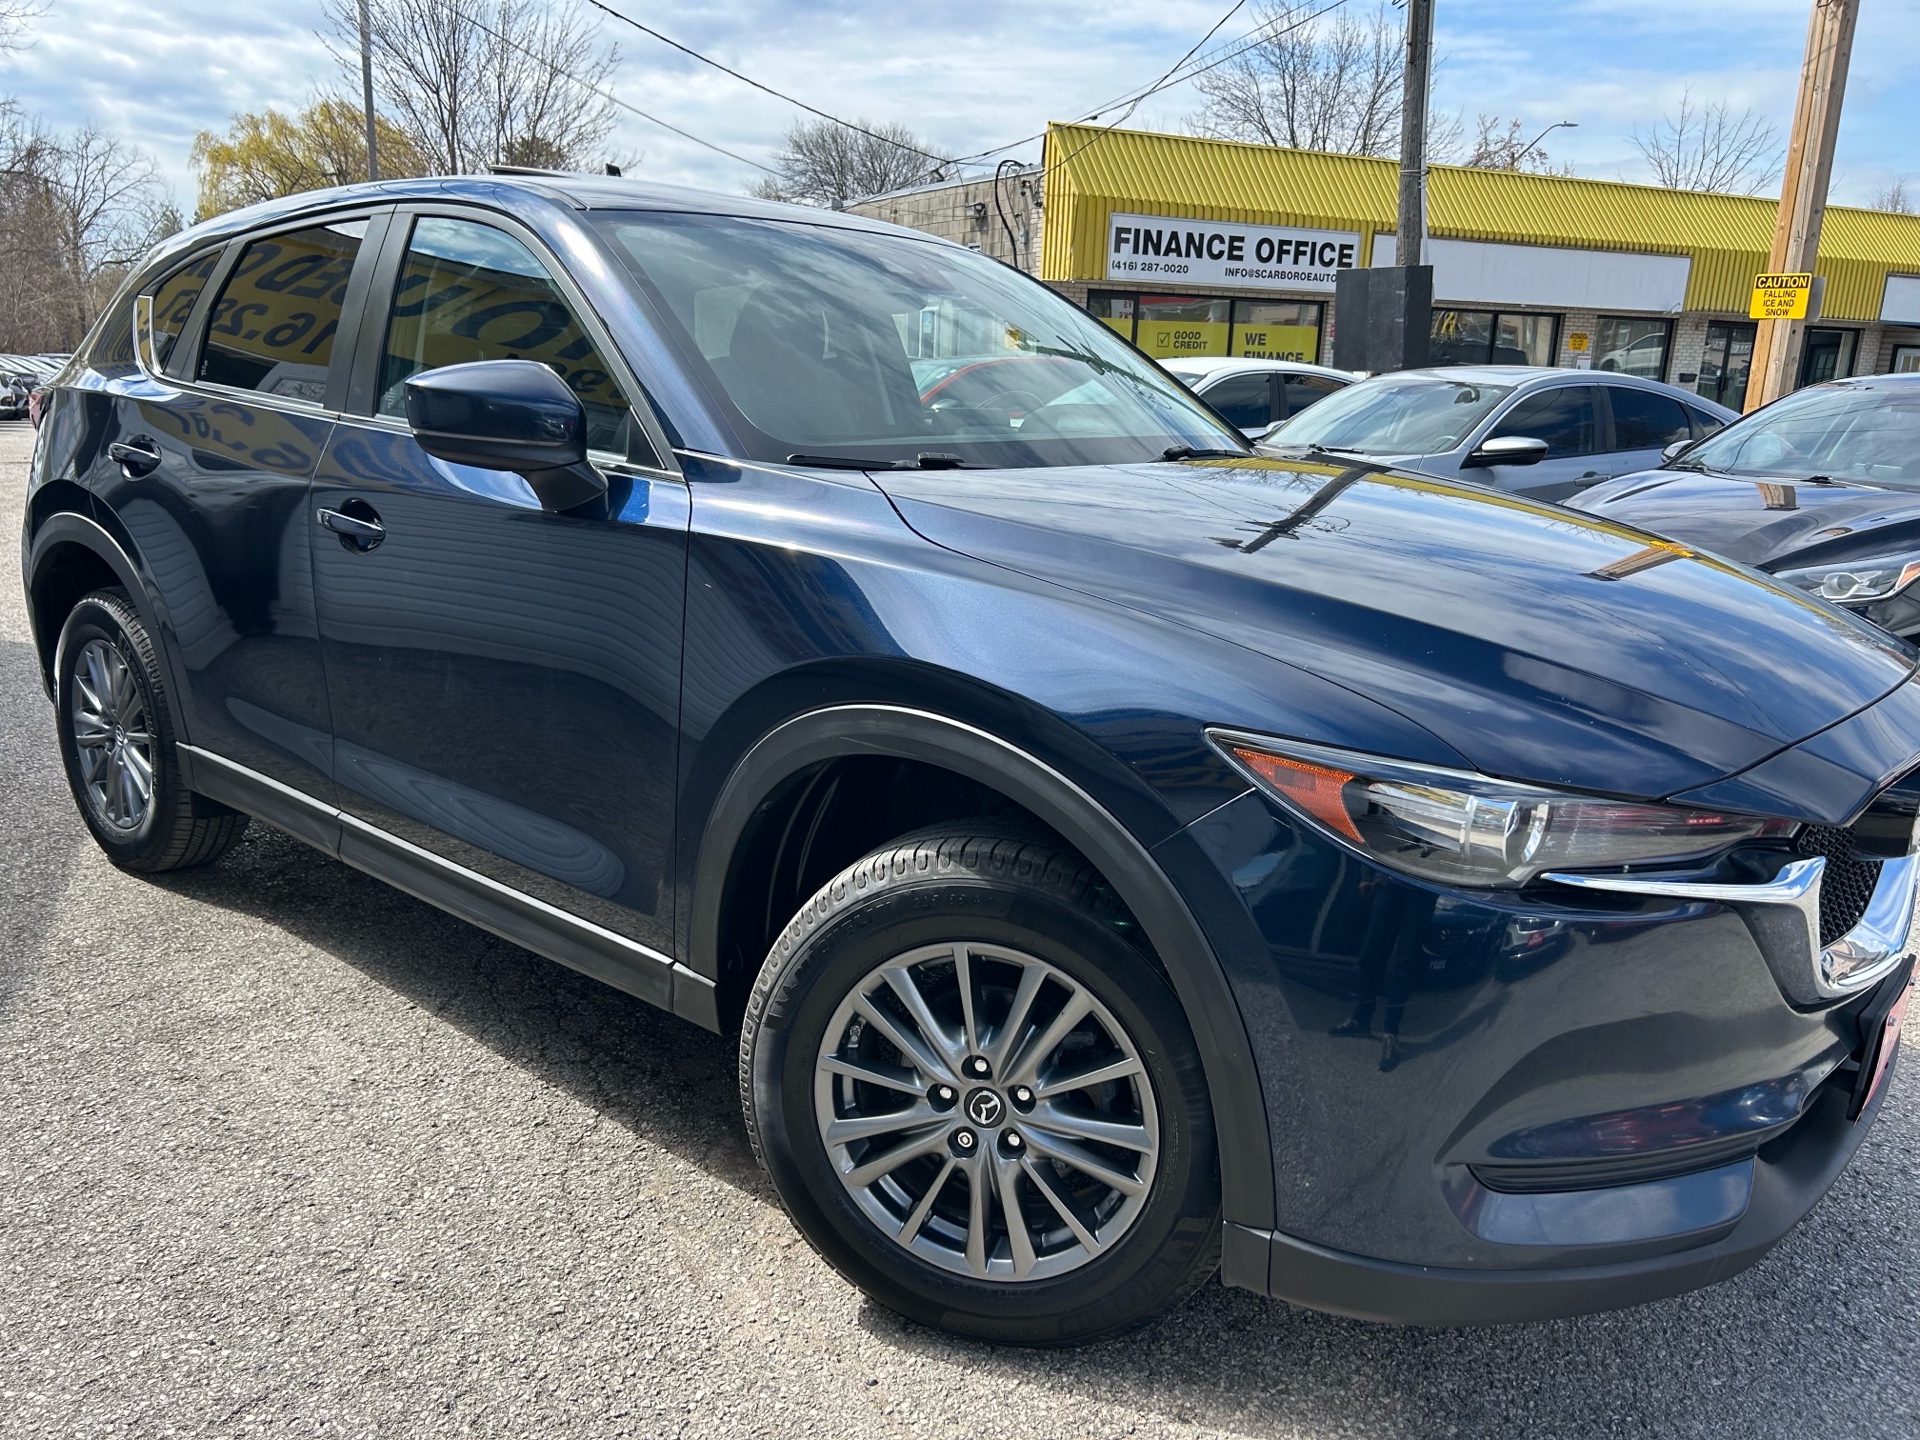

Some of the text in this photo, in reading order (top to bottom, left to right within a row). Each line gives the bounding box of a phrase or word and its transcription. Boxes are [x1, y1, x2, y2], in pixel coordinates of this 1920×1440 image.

[1113, 227, 1354, 268] FINANCE OFFICE
[1111, 260, 1189, 274] (416) 287-0020
[1757, 276, 1808, 288] CAUTION
[1763, 289, 1797, 298] FALLING
[1763, 299, 1795, 307] ICE AND
[1765, 308, 1790, 316] SNOW
[1173, 330, 1202, 341] GOOD
[1244, 332, 1267, 346] WE
[1173, 340, 1209, 351] CREDIT
